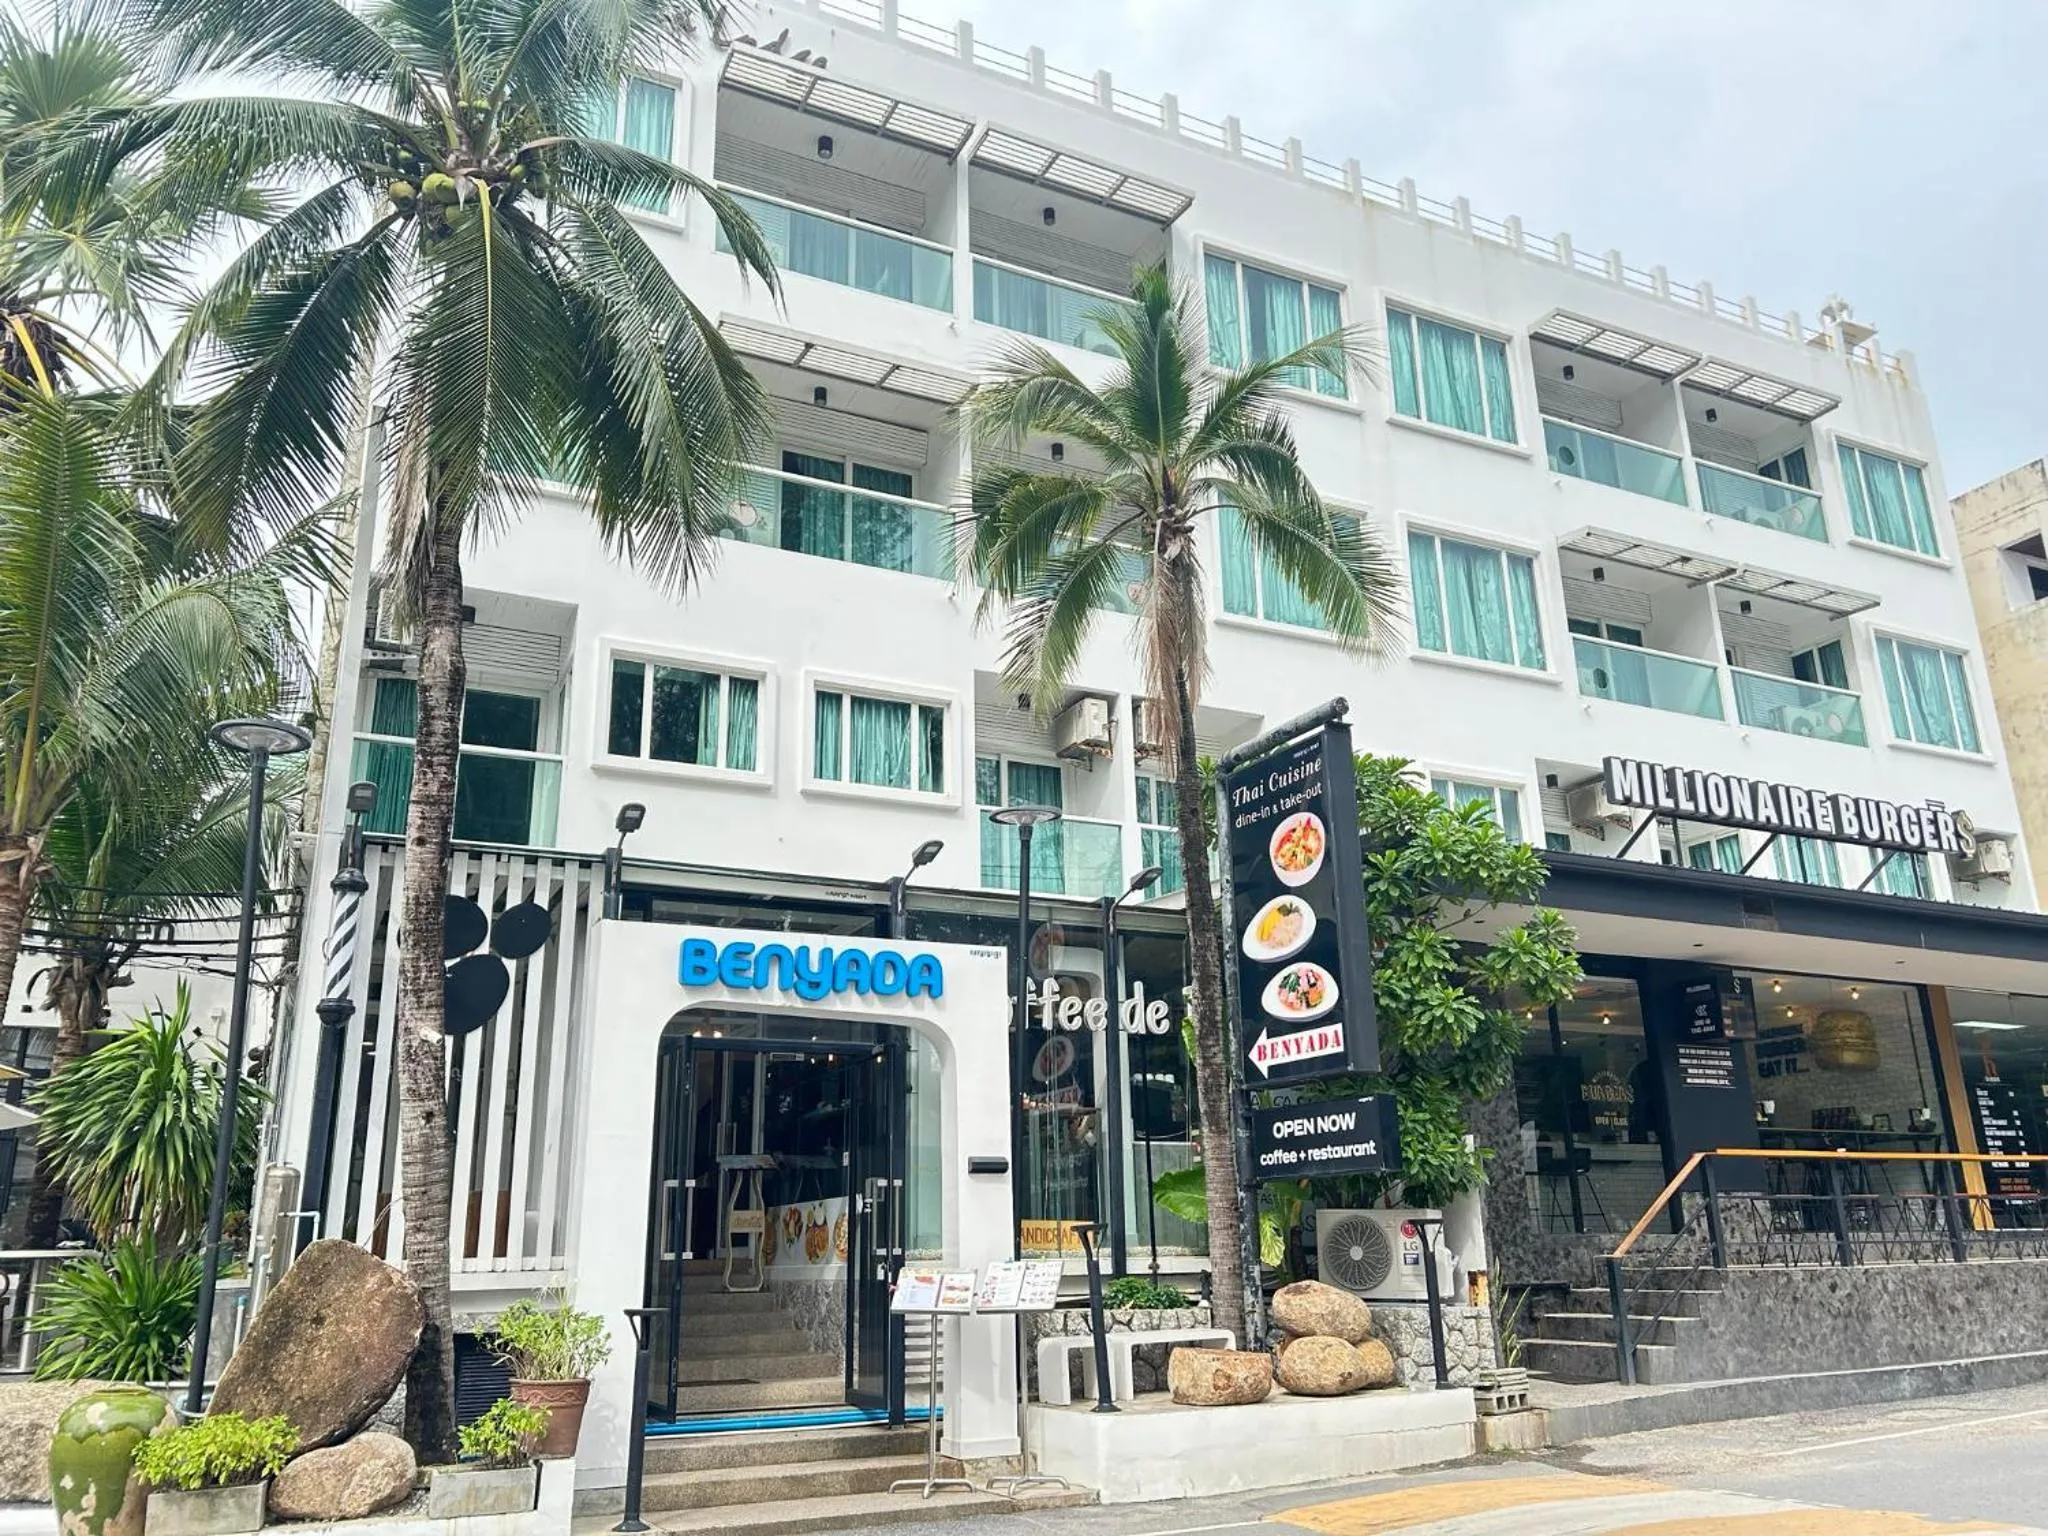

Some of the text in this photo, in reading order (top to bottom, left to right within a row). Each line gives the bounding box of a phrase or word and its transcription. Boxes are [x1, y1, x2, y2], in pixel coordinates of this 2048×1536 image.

[1232, 758, 1322, 808] Thai Cuisine
[1235, 805, 1271, 828] dine-in
[1280, 782, 1323, 811] take-out
[1606, 757, 1834, 834] MILLIONAIRE
[678, 938, 944, 1001] BENYADA
[1122, 980, 1170, 1034] de
[1257, 1029, 1341, 1062] BENYADA
[1272, 1112, 1356, 1139] OPEN NOW
[1260, 1148, 1298, 1166] coffee
[1307, 1140, 1377, 1161] restaurant
[1403, 1240, 1418, 1251] LG
